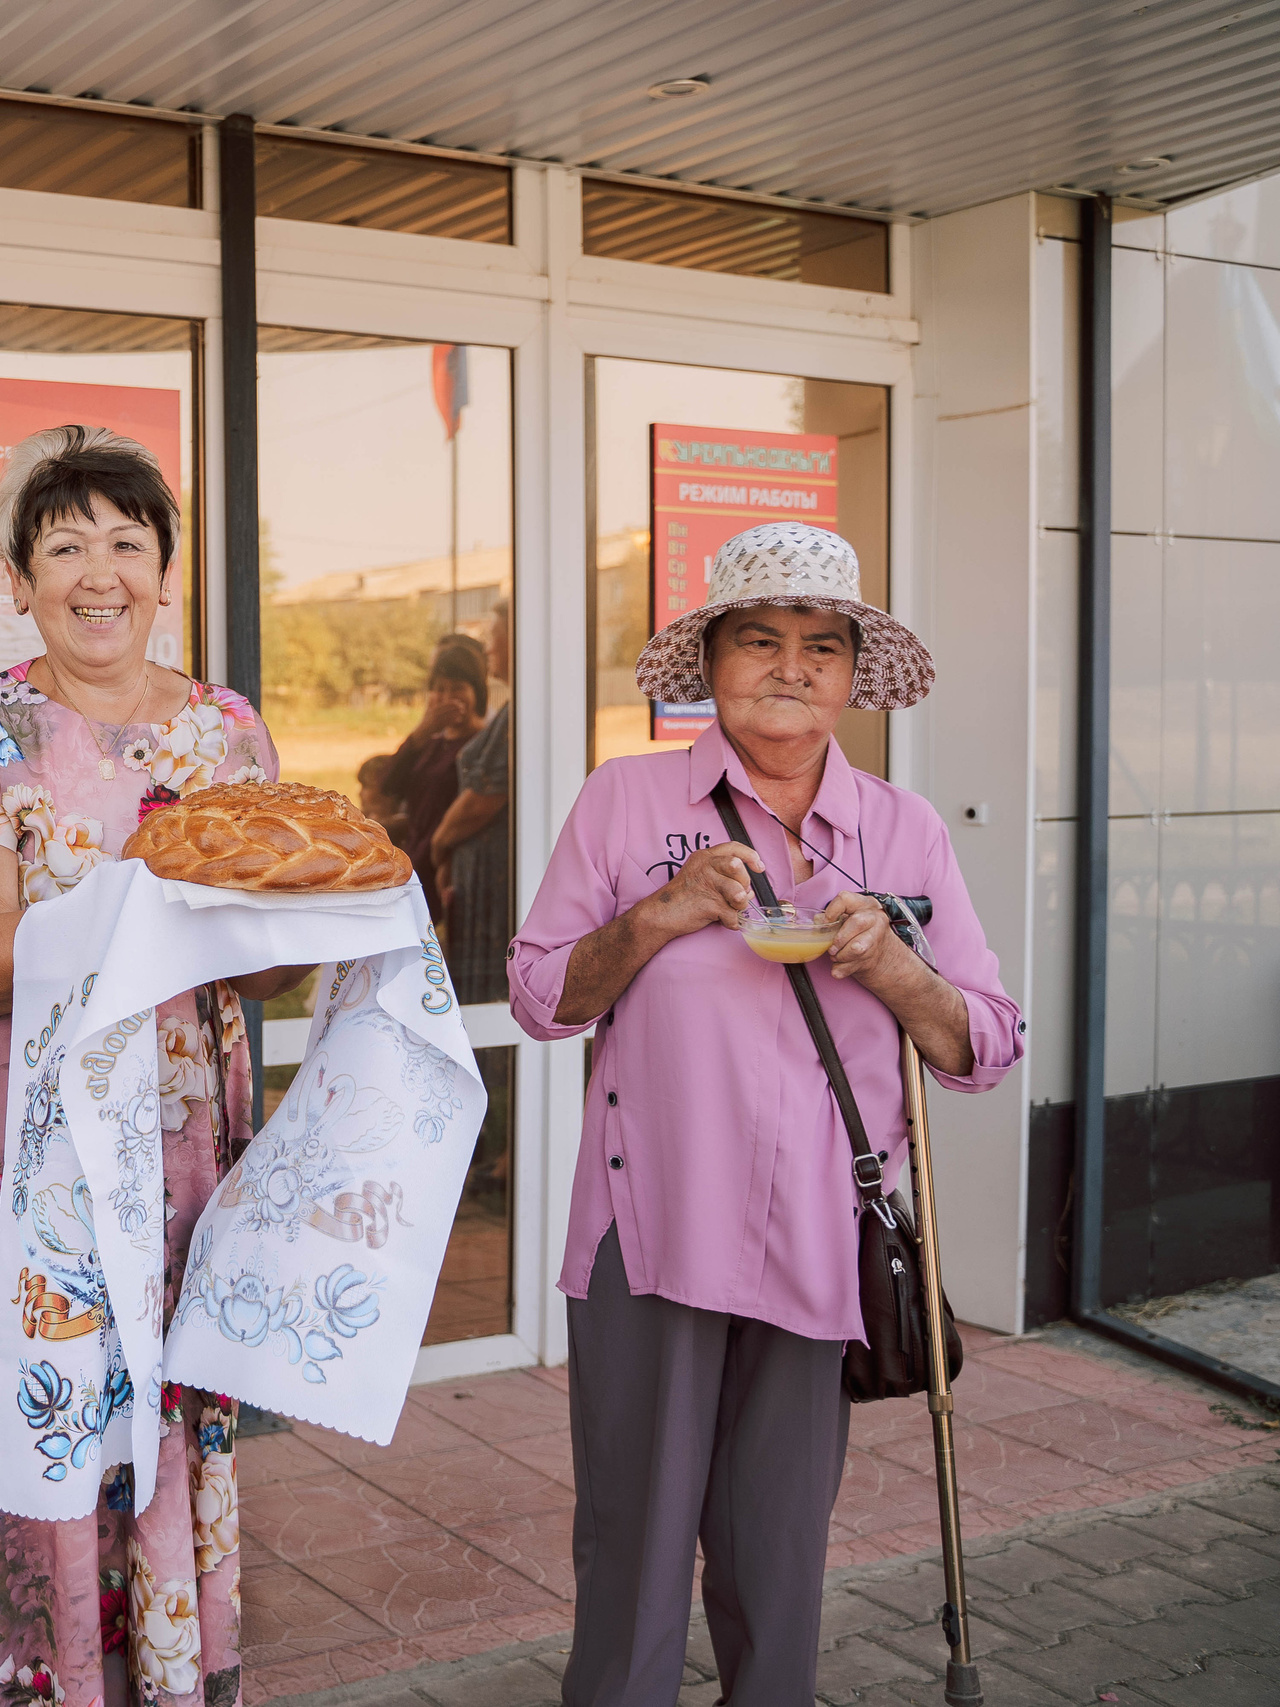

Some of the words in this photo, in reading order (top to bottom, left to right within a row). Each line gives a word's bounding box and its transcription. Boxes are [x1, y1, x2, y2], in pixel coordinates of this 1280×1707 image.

[679, 482, 747, 505] РЕЖИМ
[749, 487, 818, 510] РАБОТЫ
[668, 539, 687, 556] Вт
[668, 558, 687, 577] Ср
[668, 577, 687, 592] Чт
